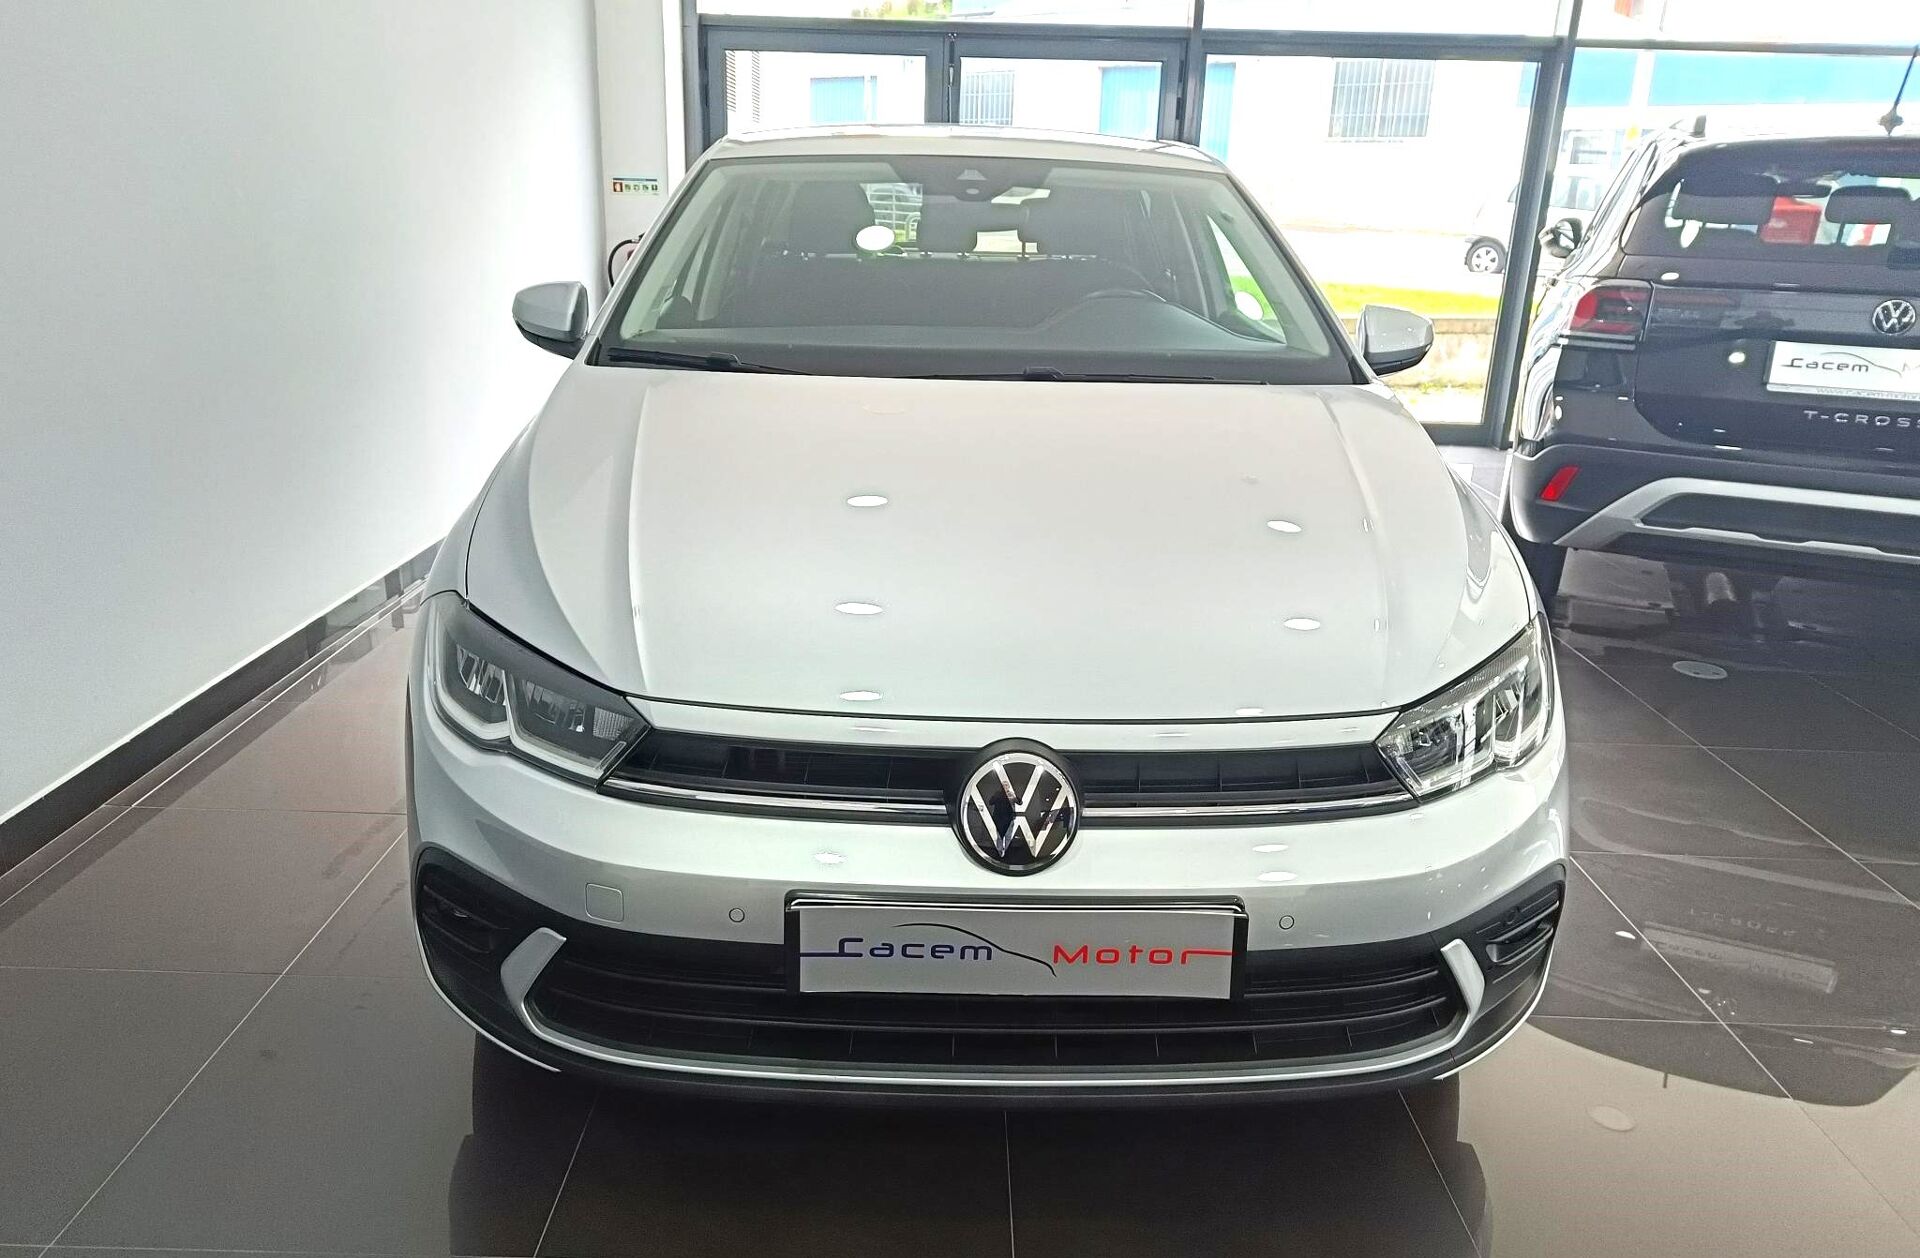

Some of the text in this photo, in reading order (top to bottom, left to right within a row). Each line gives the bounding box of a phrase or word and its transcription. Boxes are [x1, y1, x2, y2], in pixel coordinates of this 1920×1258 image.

[1788, 357, 1869, 373] Cacem
[1803, 410, 1920, 428] T-CROS
[837, 937, 1232, 965] Cacem Motor
